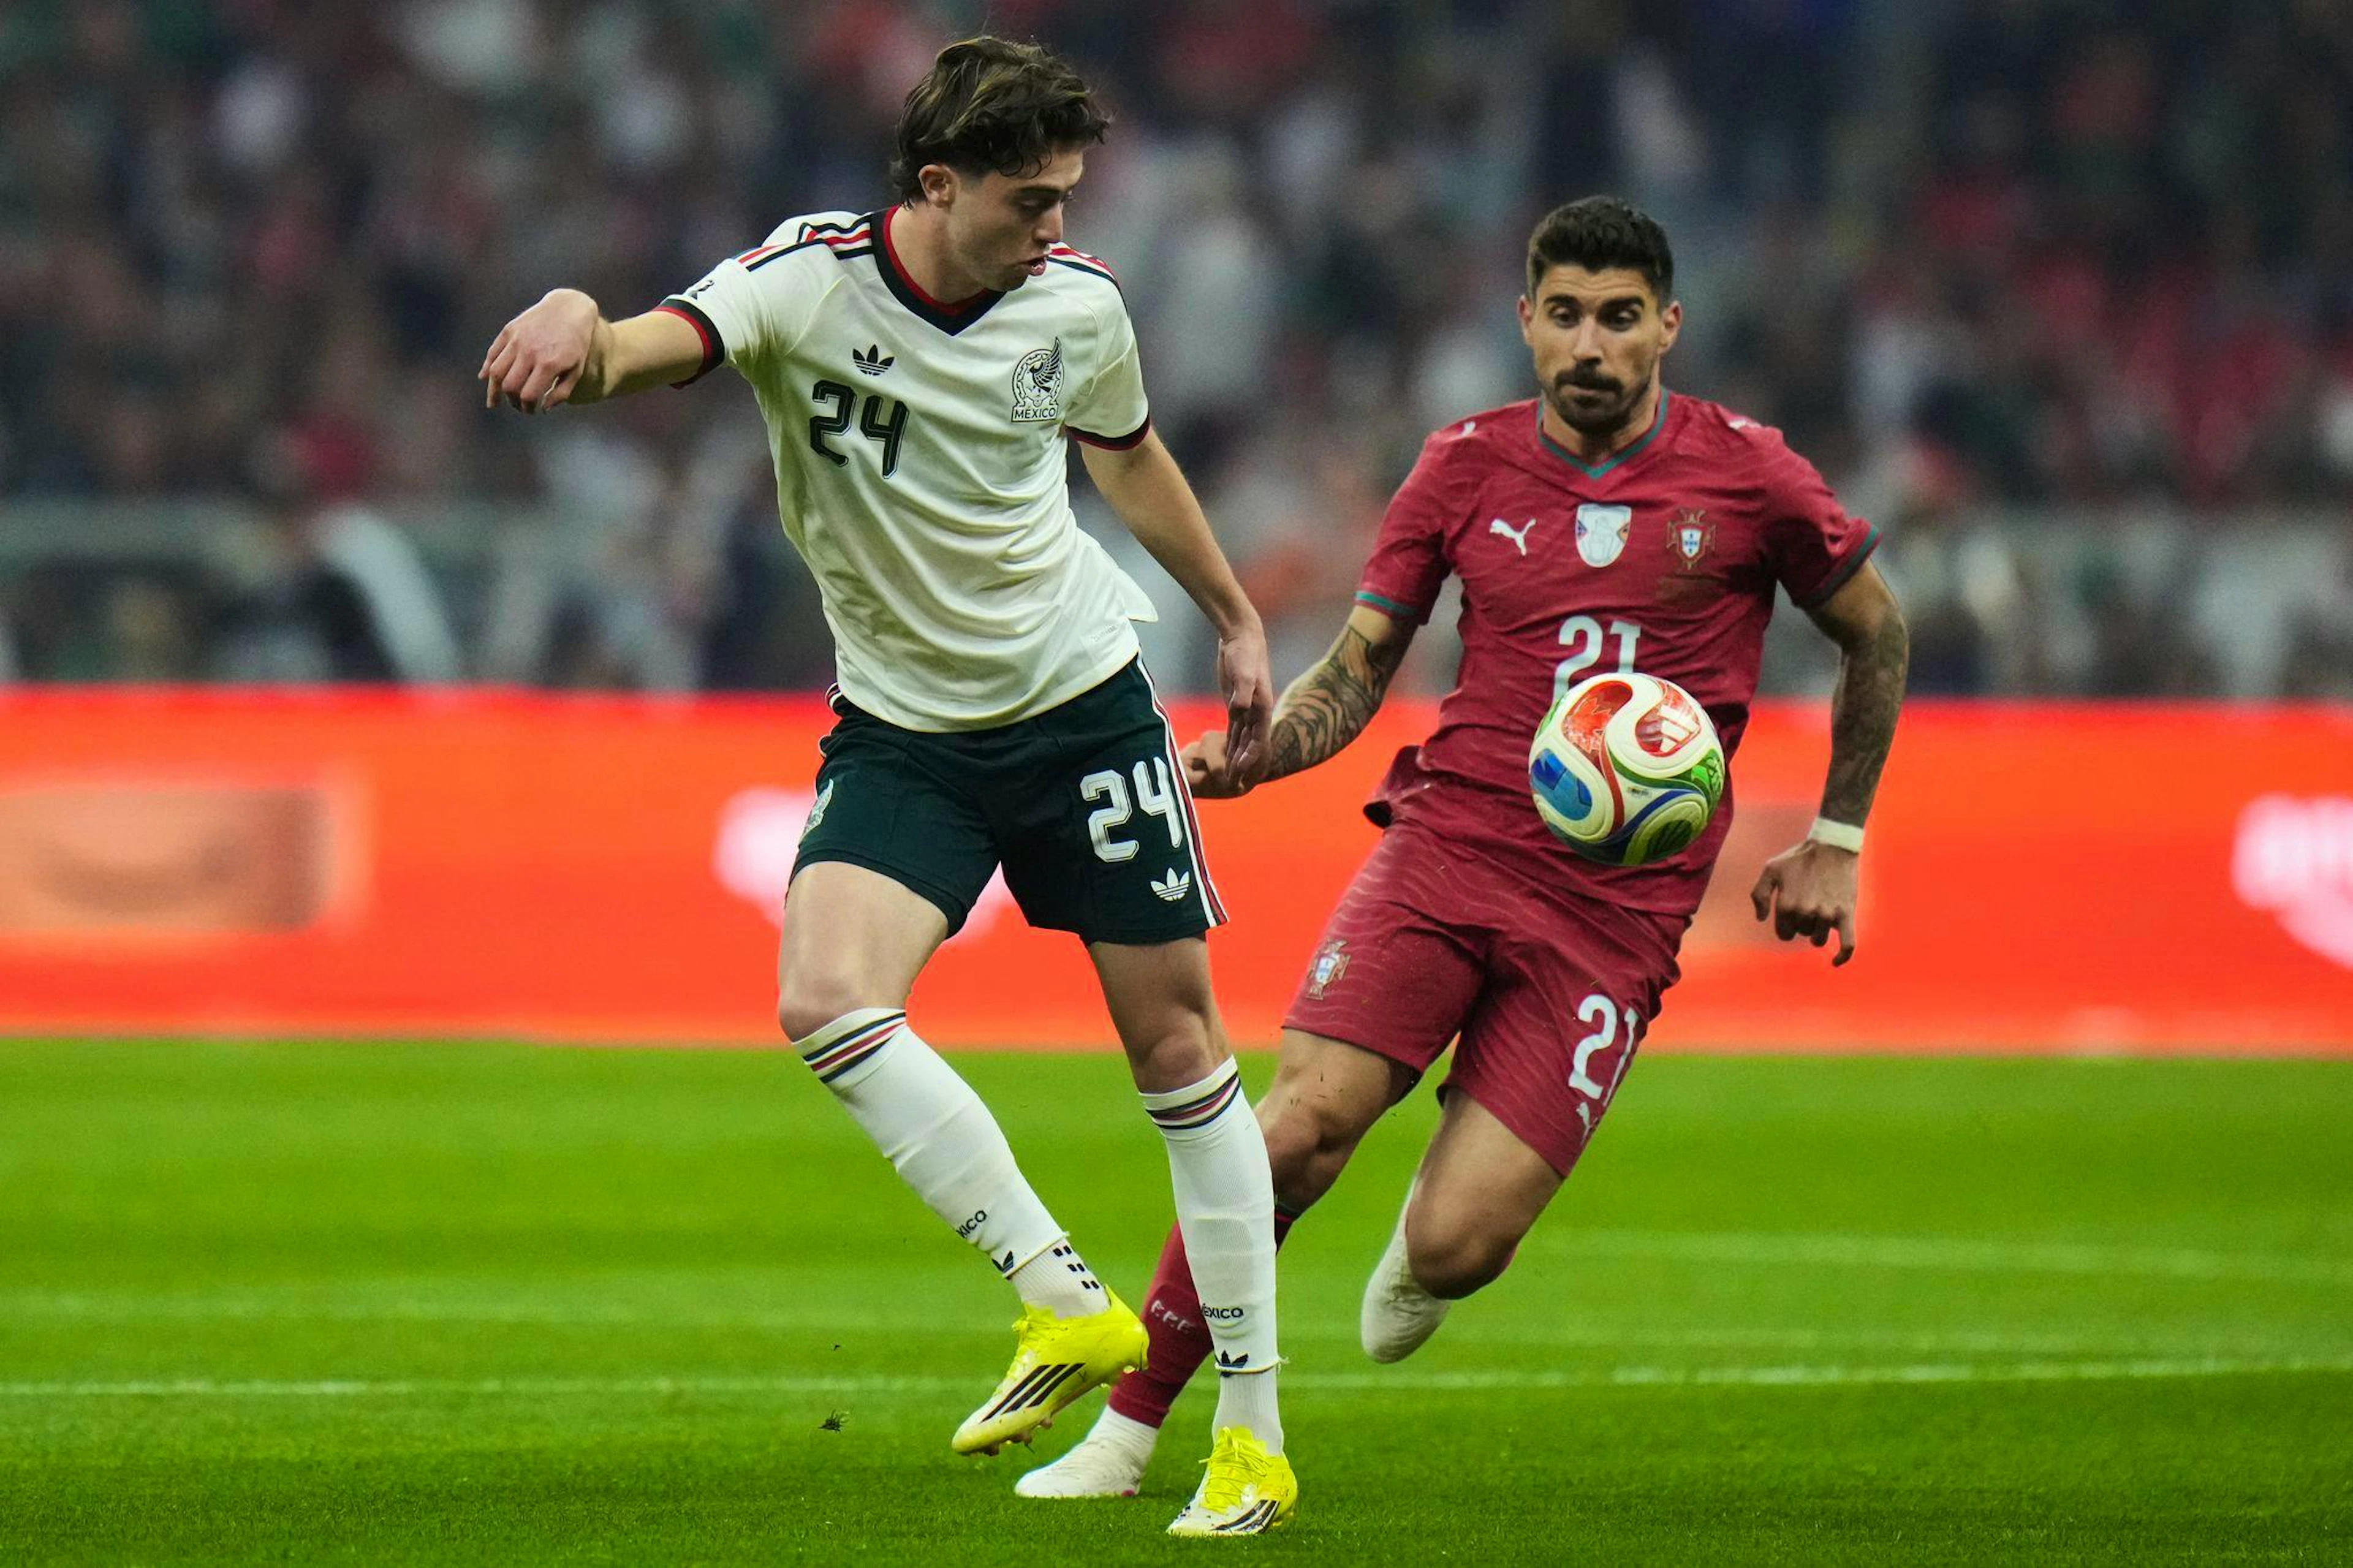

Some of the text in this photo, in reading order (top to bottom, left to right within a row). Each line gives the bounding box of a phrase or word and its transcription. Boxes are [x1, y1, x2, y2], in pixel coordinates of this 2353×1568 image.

[809, 380, 909, 479] 24
[1014, 406, 1055, 419] MÉXICO
[1080, 757, 1183, 863] 24
[1568, 994, 1639, 1107] 21
[956, 1210, 987, 1238] XICO
[1201, 1303, 1243, 1319] ÉXICO
